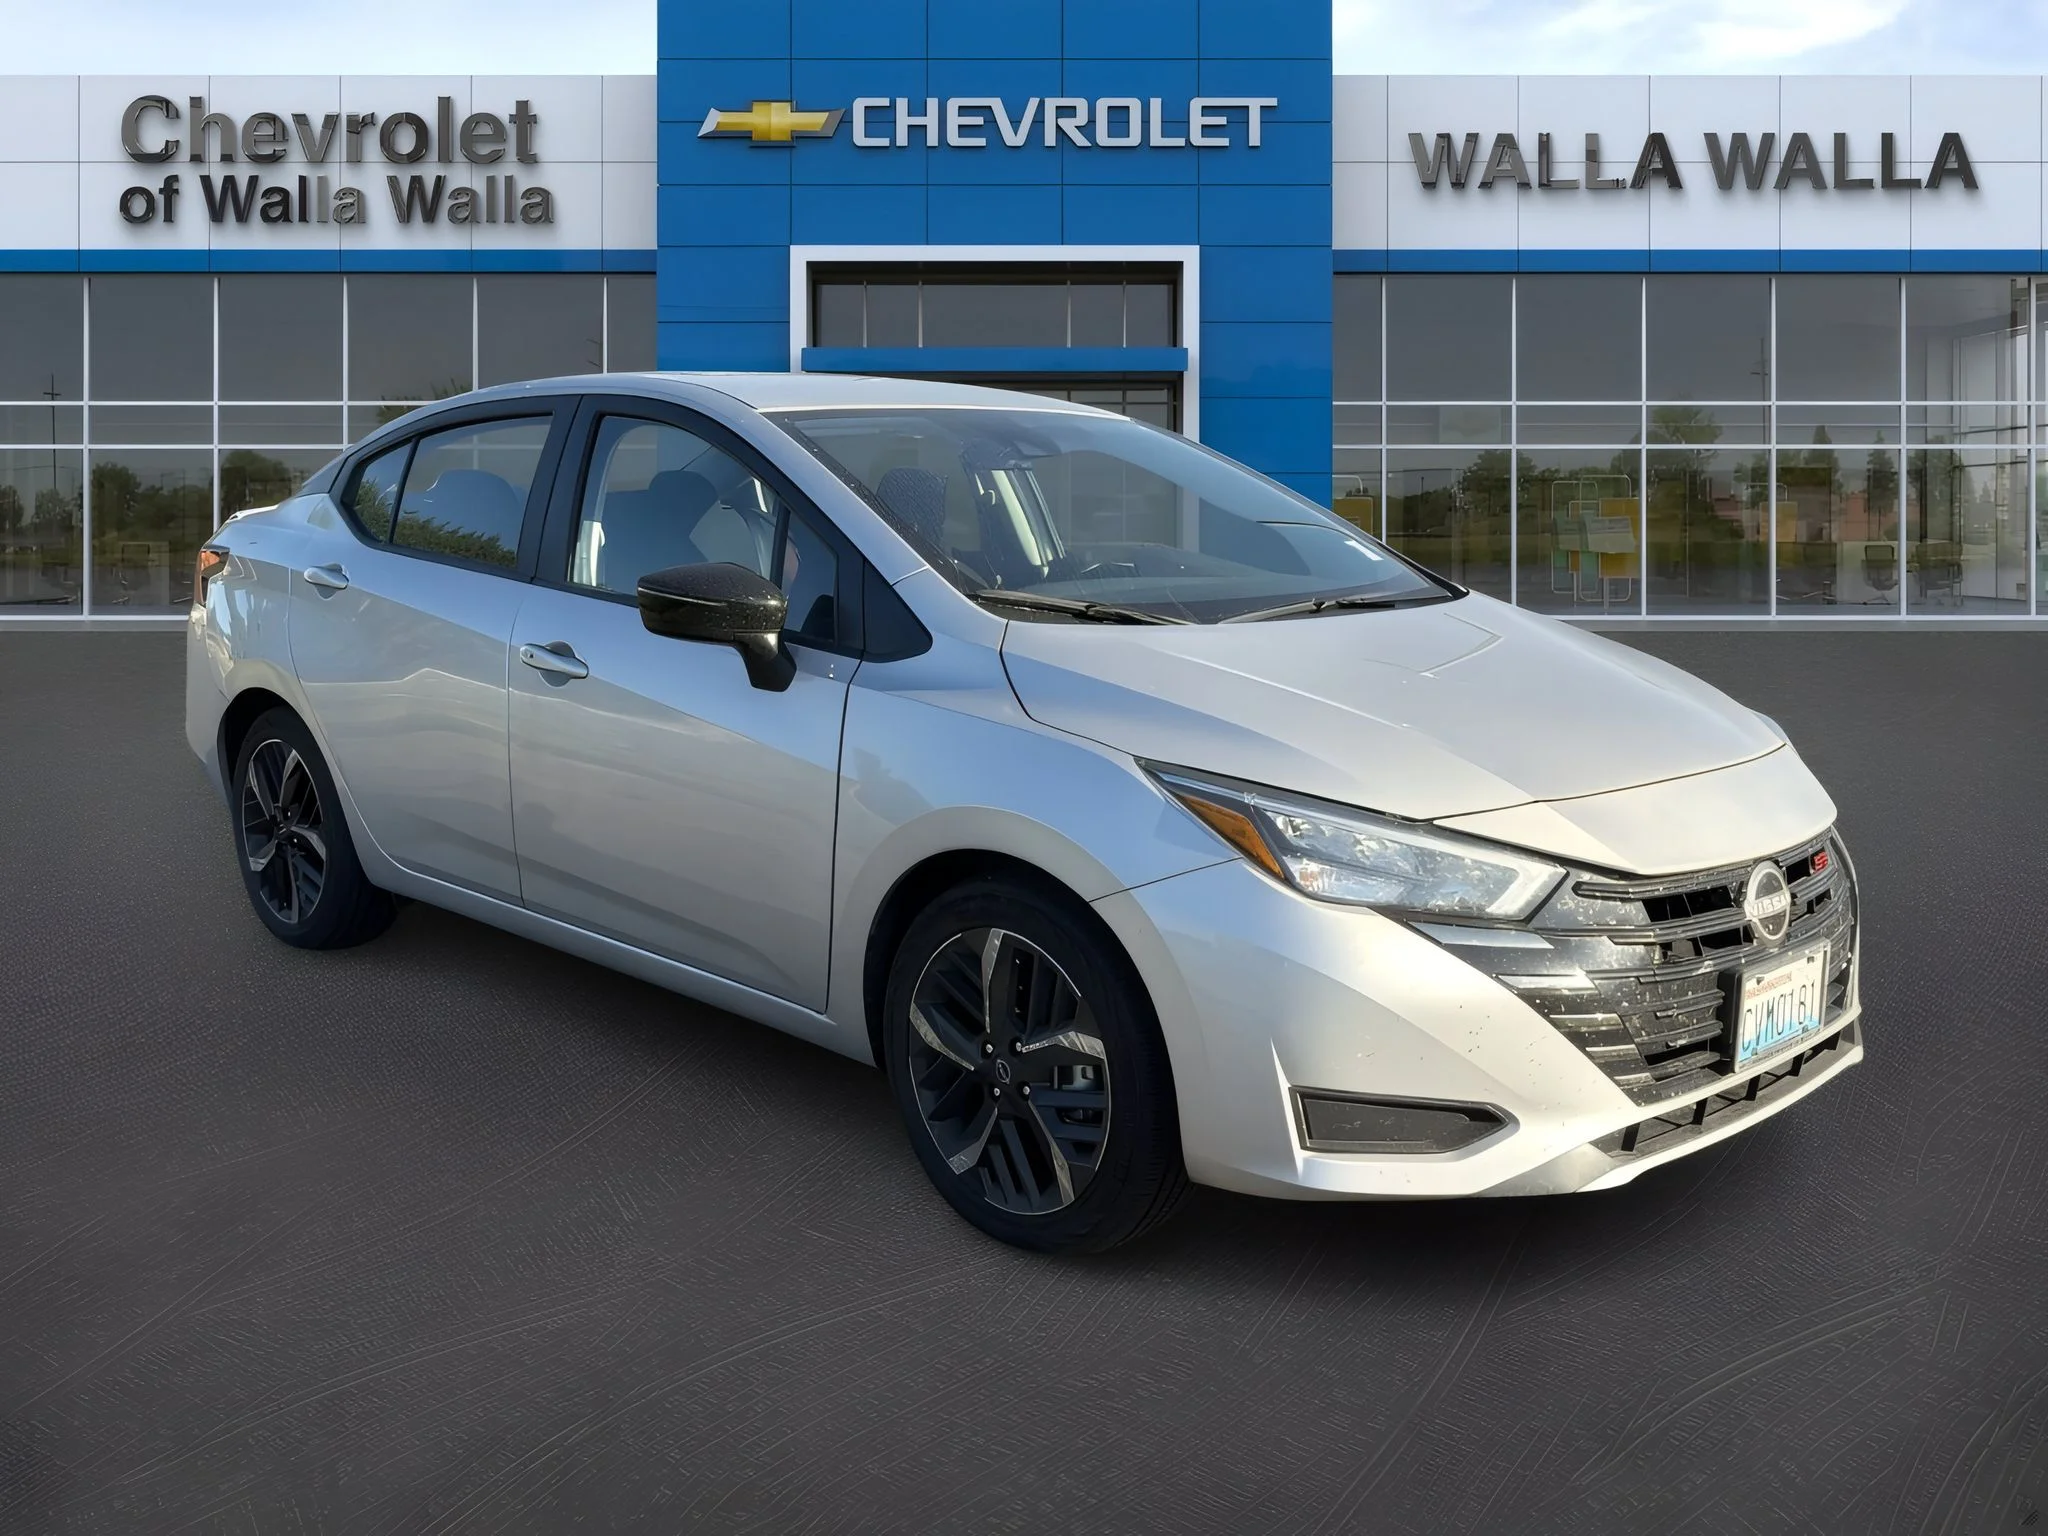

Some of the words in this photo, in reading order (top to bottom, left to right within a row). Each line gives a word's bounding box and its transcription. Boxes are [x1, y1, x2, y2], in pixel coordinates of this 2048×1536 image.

[121, 95, 537, 164] Chevrolet
[853, 97, 1278, 147] CHEVROLET
[1408, 132, 1683, 189] WALLA
[1704, 132, 1979, 189] WALLA
[119, 174, 179, 224] of
[200, 174, 366, 224] Walla
[387, 174, 555, 224] Walla
